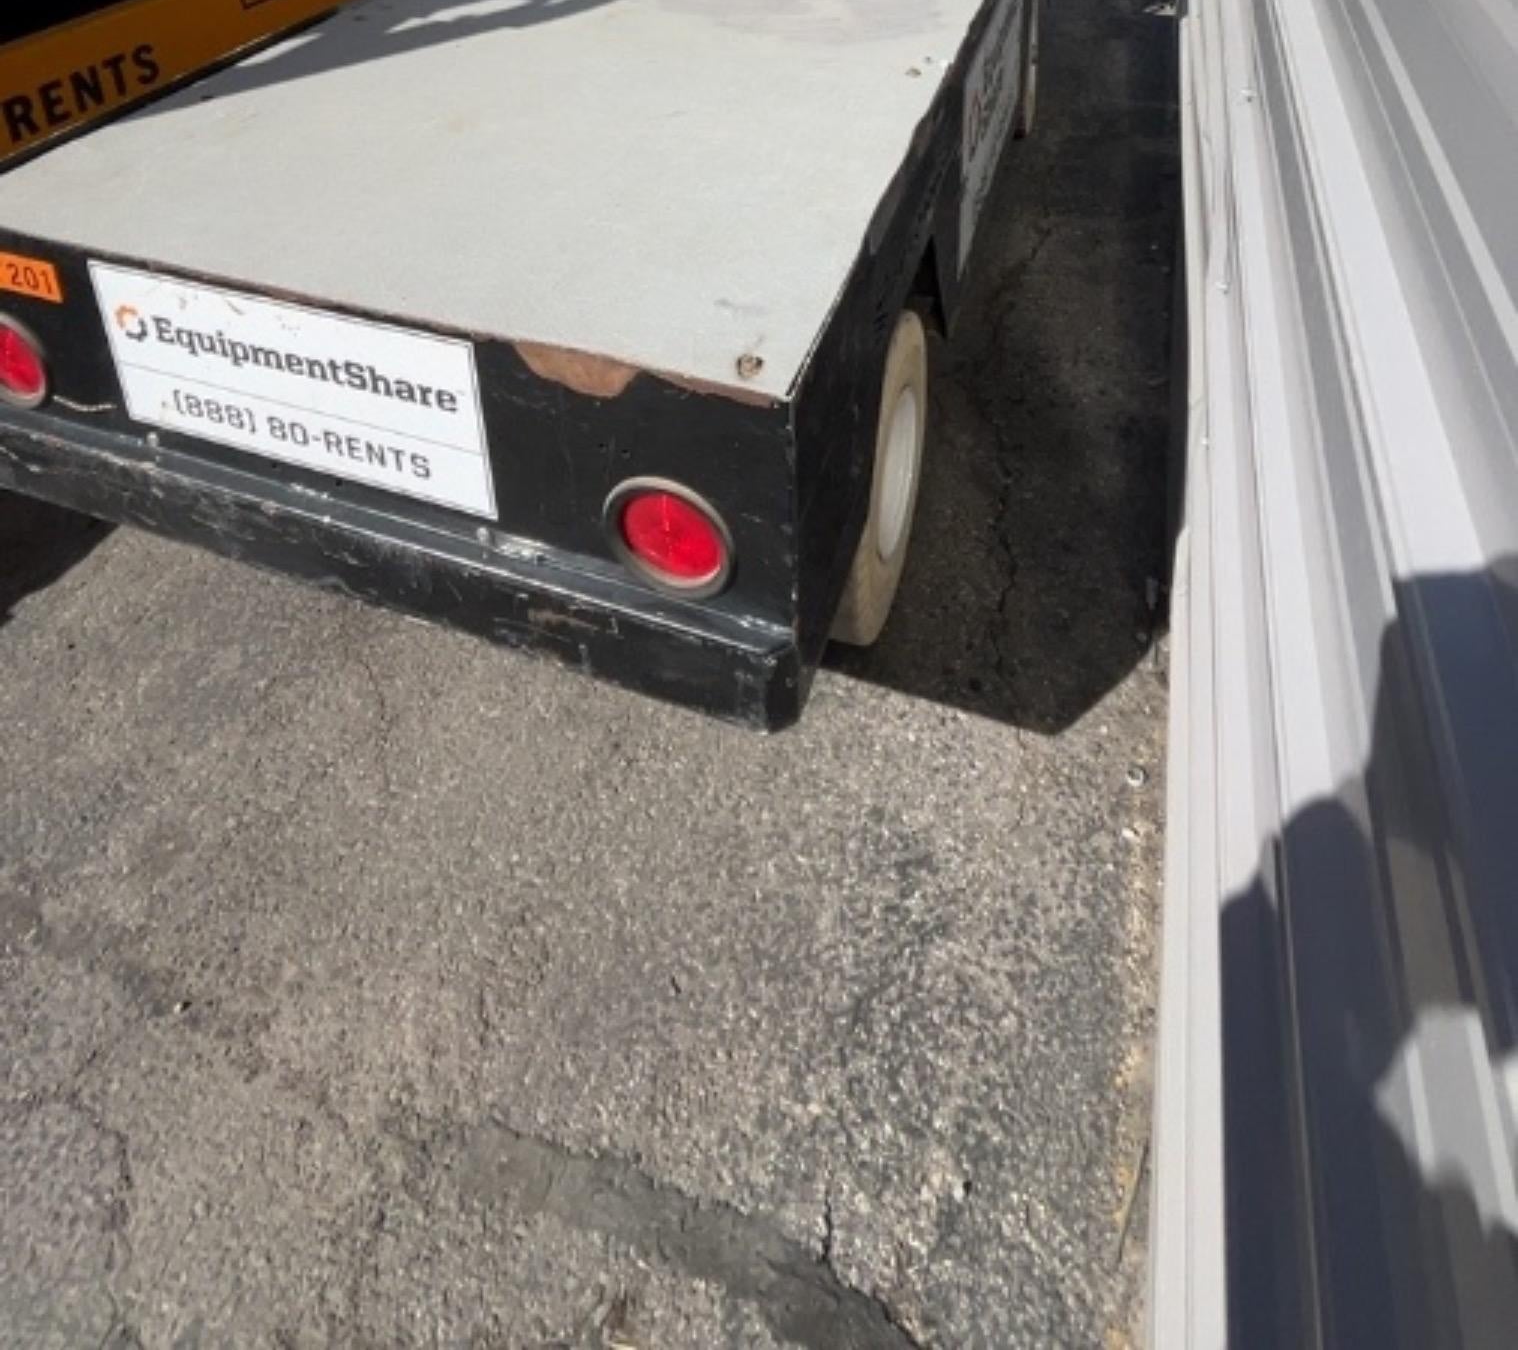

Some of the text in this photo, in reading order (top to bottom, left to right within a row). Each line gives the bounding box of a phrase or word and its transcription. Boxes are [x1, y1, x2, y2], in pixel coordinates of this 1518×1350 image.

[2, 43, 160, 144] RENTS
[5, 262, 53, 295] 201
[152, 316, 459, 413] EquipmentShare
[172, 388, 432, 480] (888) 80-RENTS
